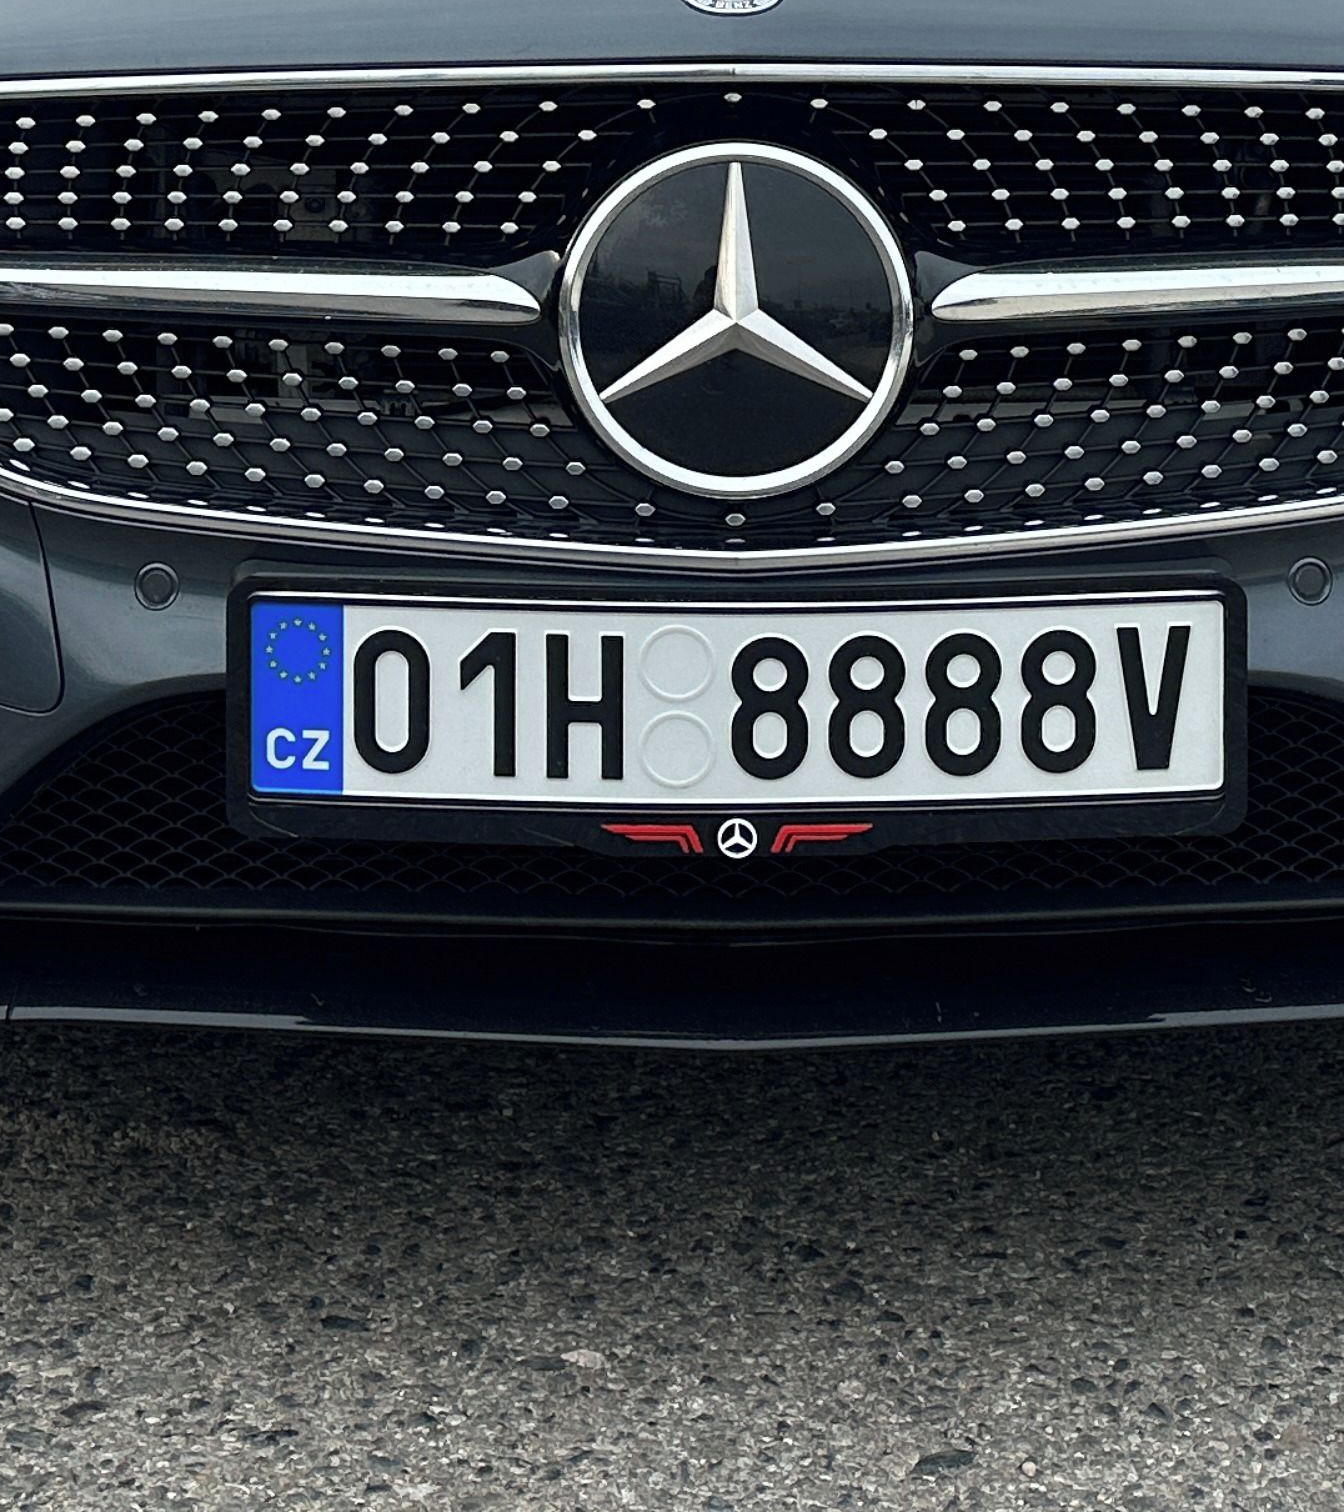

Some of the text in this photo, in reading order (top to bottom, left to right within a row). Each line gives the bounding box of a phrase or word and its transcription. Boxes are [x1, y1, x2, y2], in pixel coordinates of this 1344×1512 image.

[266, 727, 331, 771] CZ
[353, 625, 1192, 781] 01H 8888V
